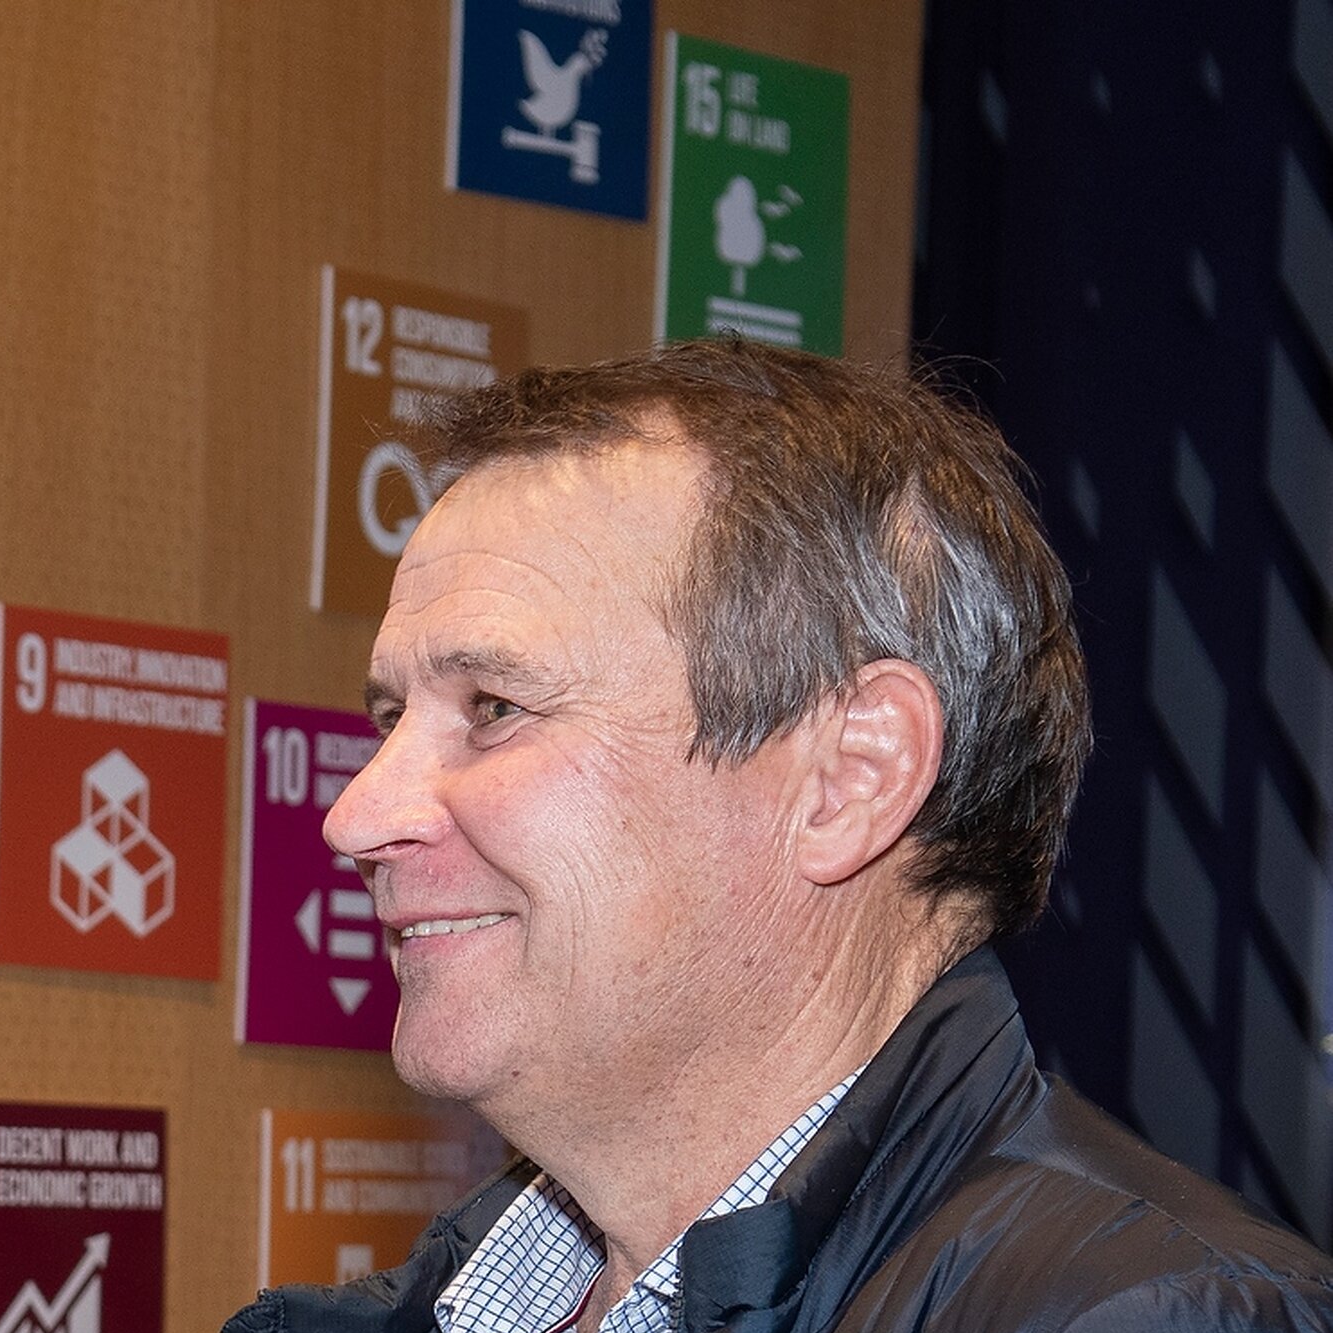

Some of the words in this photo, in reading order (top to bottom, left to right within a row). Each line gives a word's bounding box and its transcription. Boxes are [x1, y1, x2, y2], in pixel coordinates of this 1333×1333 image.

[684, 61, 722, 138] 15
[343, 296, 384, 377] 12
[16, 632, 47, 714] 9
[263, 726, 309, 807] 10
[64, 1128, 120, 1168] WORK
[119, 1131, 160, 1169] AND
[281, 1136, 316, 1214] 11
[87, 1171, 164, 1211] GROWTH
